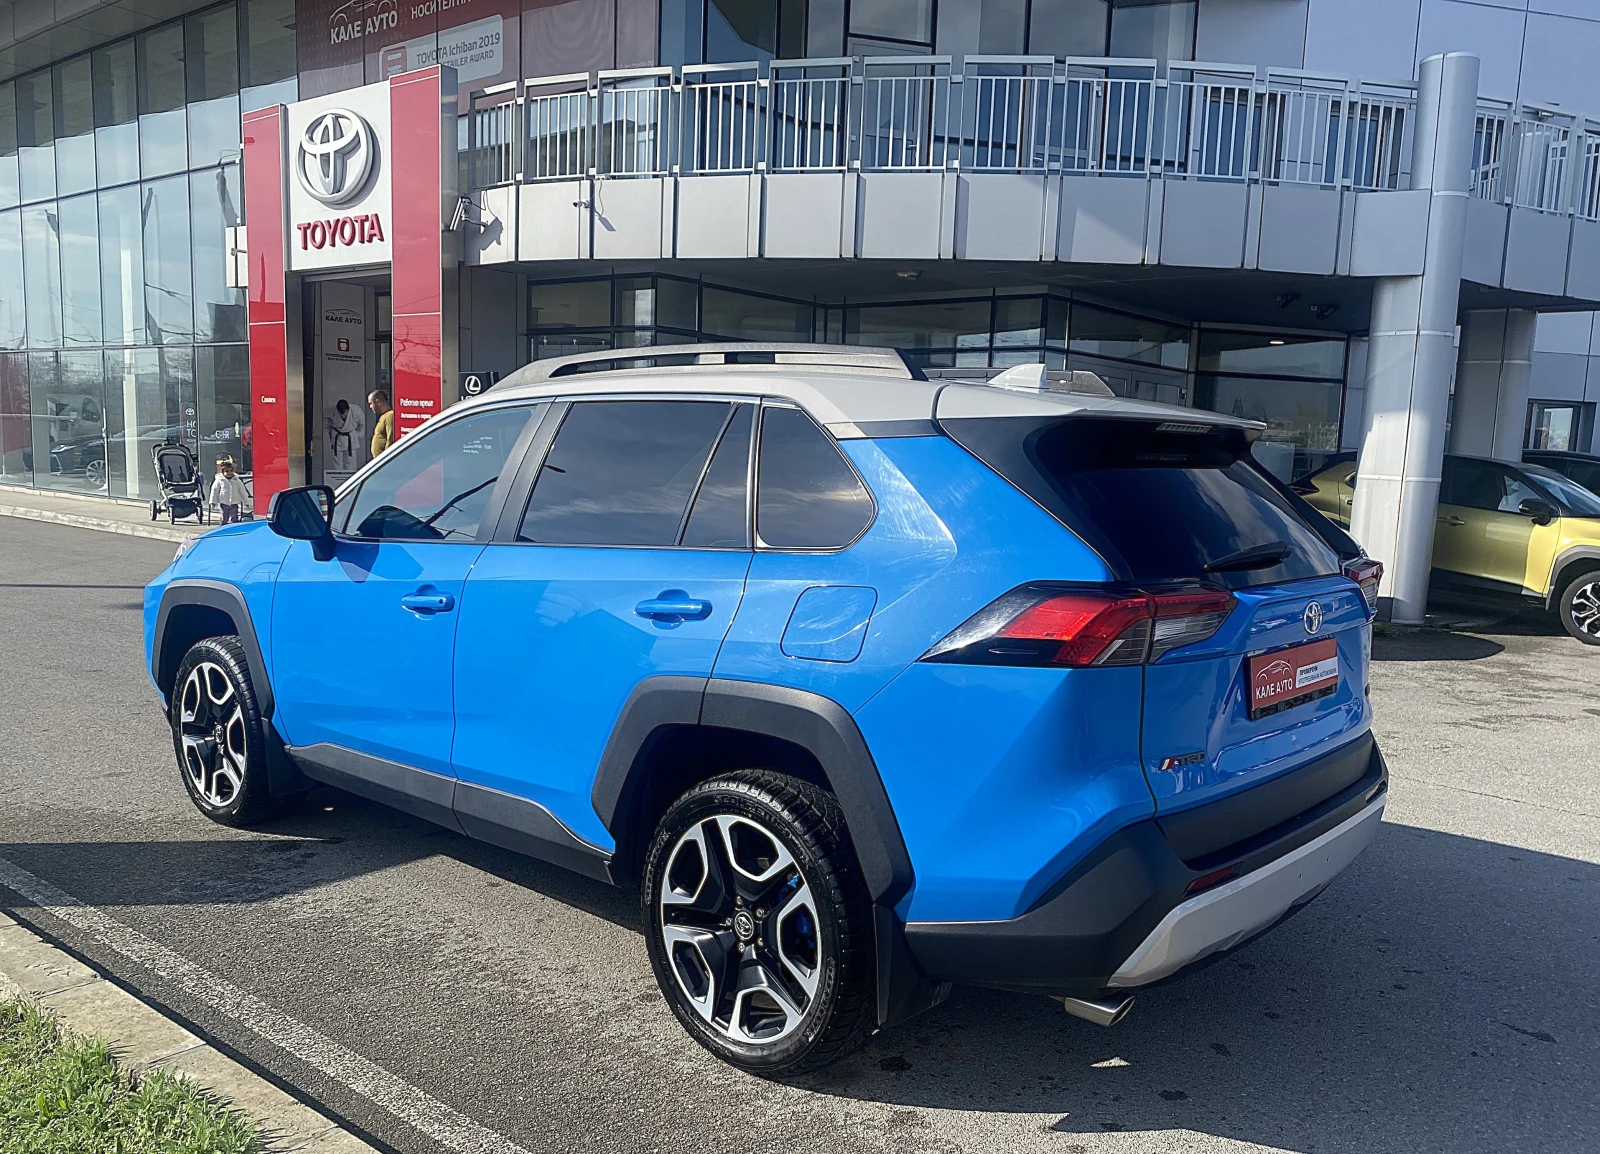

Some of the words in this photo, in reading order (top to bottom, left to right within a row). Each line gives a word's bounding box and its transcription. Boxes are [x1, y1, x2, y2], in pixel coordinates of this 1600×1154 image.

[330, 21, 362, 45] КАЛЕ
[365, 10, 398, 35] АУТО
[416, 46, 448, 65] TOYOTA
[449, 41, 477, 57] Ichiban
[478, 32, 500, 49] 2019
[442, 56, 469, 68] ETAILER
[469, 49, 494, 63] AWARD
[297, 213, 385, 251] TOYOTA
[325, 315, 344, 323] КАЛЕ
[344, 317, 362, 325] АУТО
[1255, 683, 1275, 700] КАЛЕ
[1276, 677, 1293, 695] АУТО
